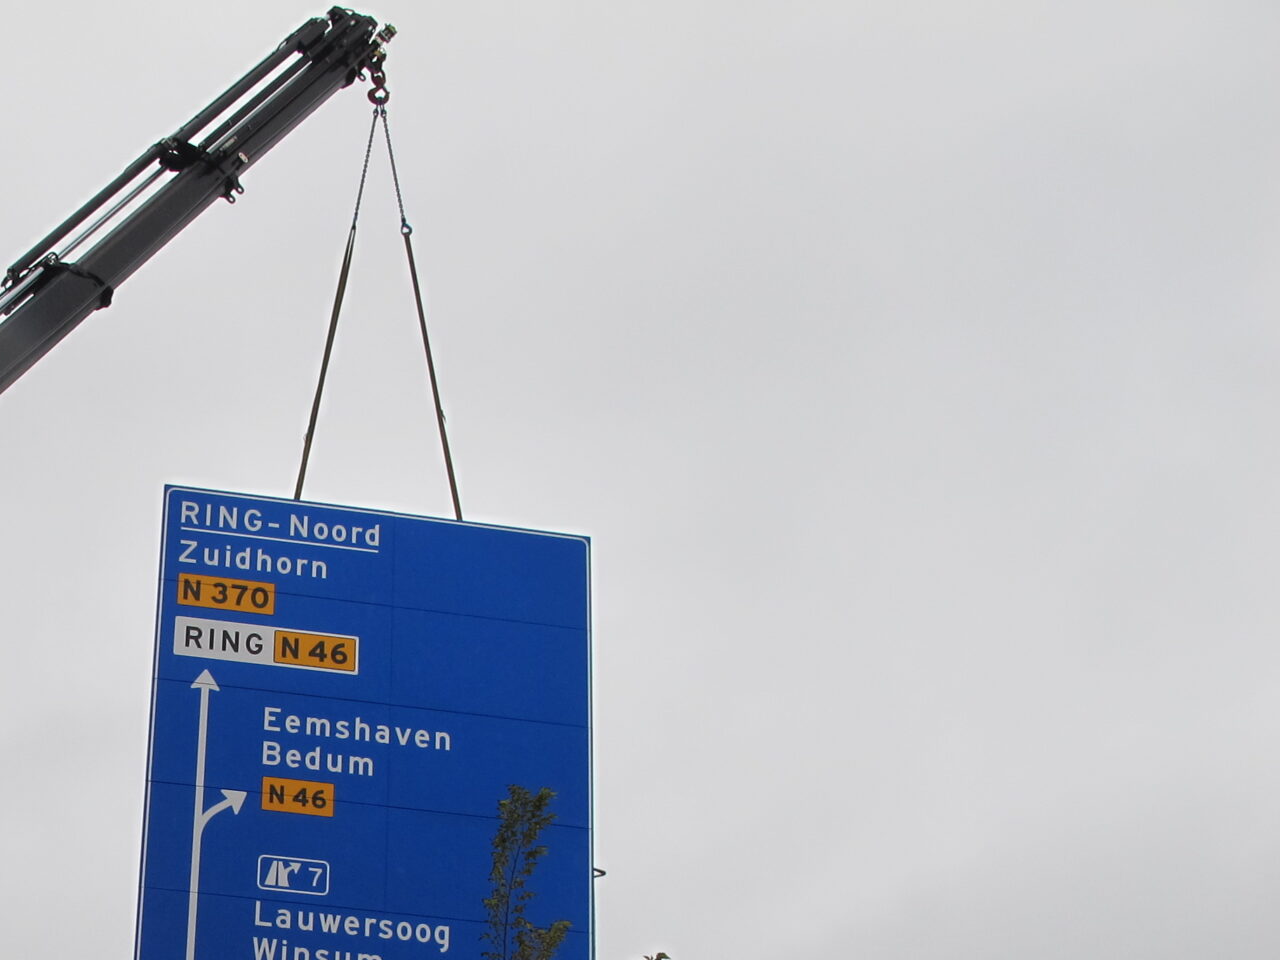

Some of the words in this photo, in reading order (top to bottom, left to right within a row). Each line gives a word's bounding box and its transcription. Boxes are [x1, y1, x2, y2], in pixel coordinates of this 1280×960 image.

[181, 501, 380, 547] RING-Noord
[178, 540, 327, 579] Zuidhorn
[183, 579, 201, 601] N
[211, 582, 269, 609] 370
[184, 625, 263, 655] RING
[281, 636, 300, 660] N
[309, 640, 348, 665] 46
[264, 706, 451, 751] Eemshaven
[262, 740, 374, 777] Bedum
[269, 784, 285, 805] N
[292, 787, 327, 809] 46
[308, 867, 323, 887] 7
[254, 900, 451, 953] Lauwersoog
